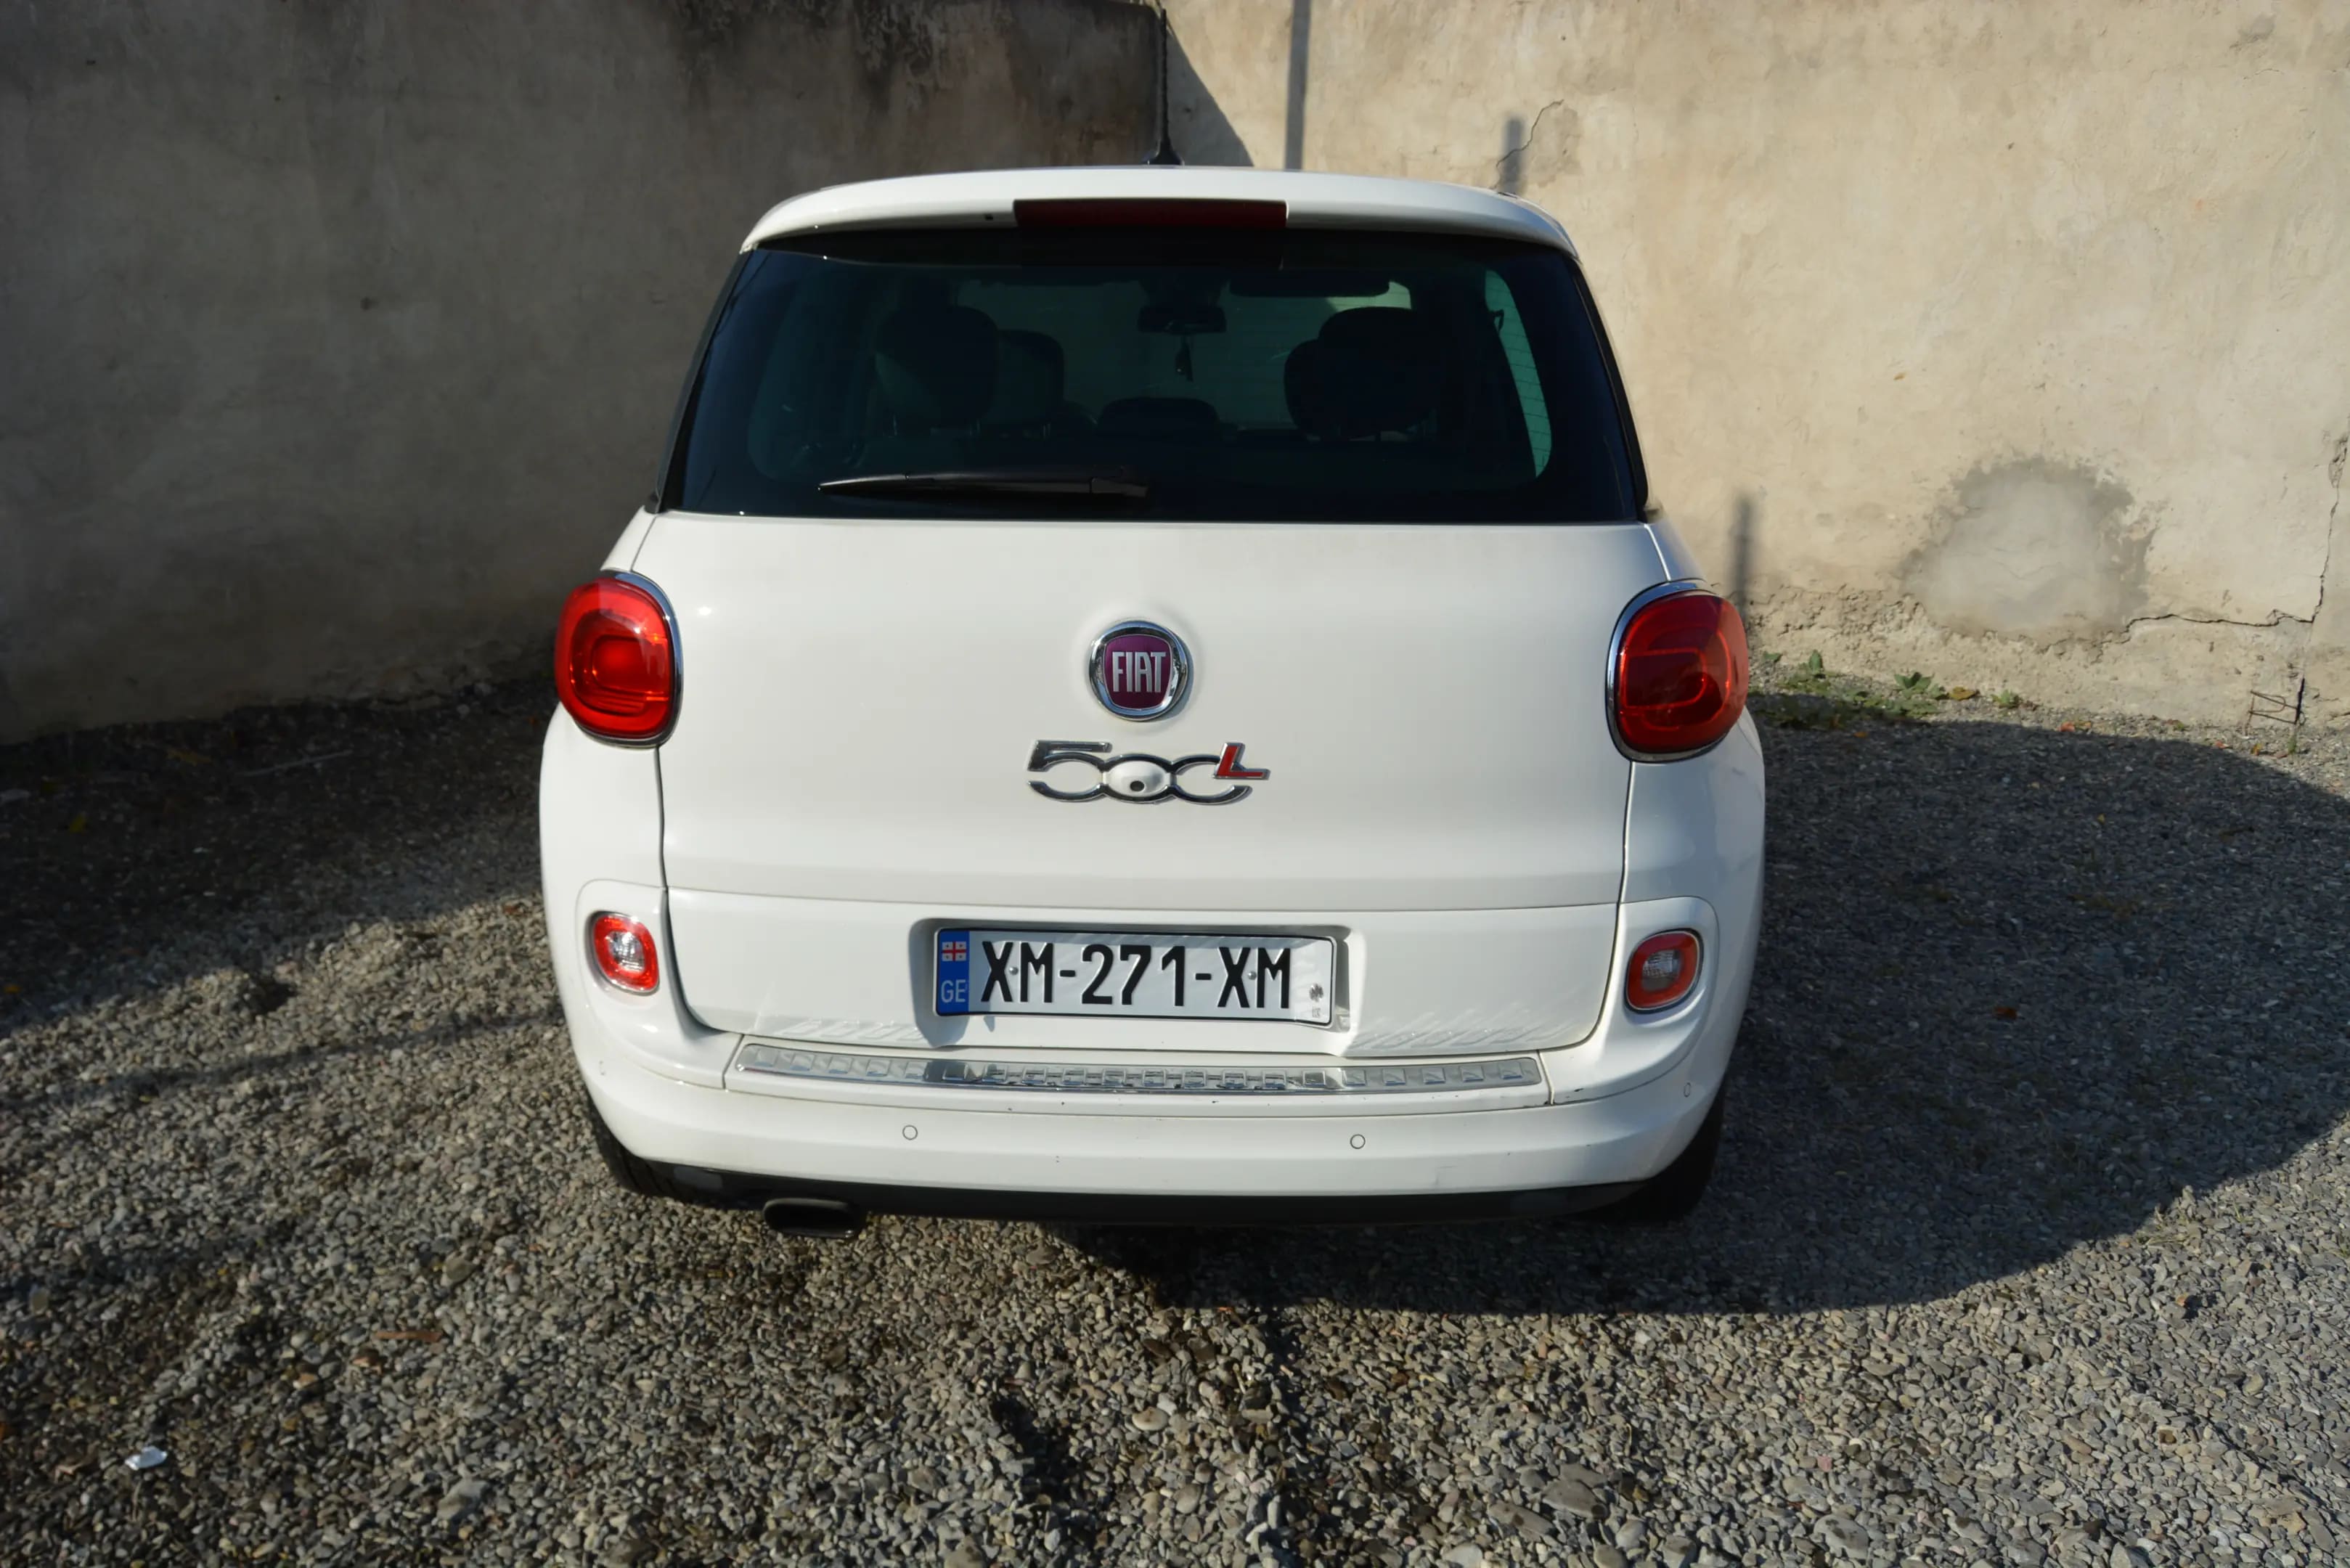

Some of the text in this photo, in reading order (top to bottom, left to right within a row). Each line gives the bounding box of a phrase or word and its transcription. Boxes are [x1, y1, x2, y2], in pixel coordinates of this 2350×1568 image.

[1112, 651, 1166, 693] FIAT
[941, 979, 966, 1003] GE
[981, 941, 1290, 1009] XM-271-XM
